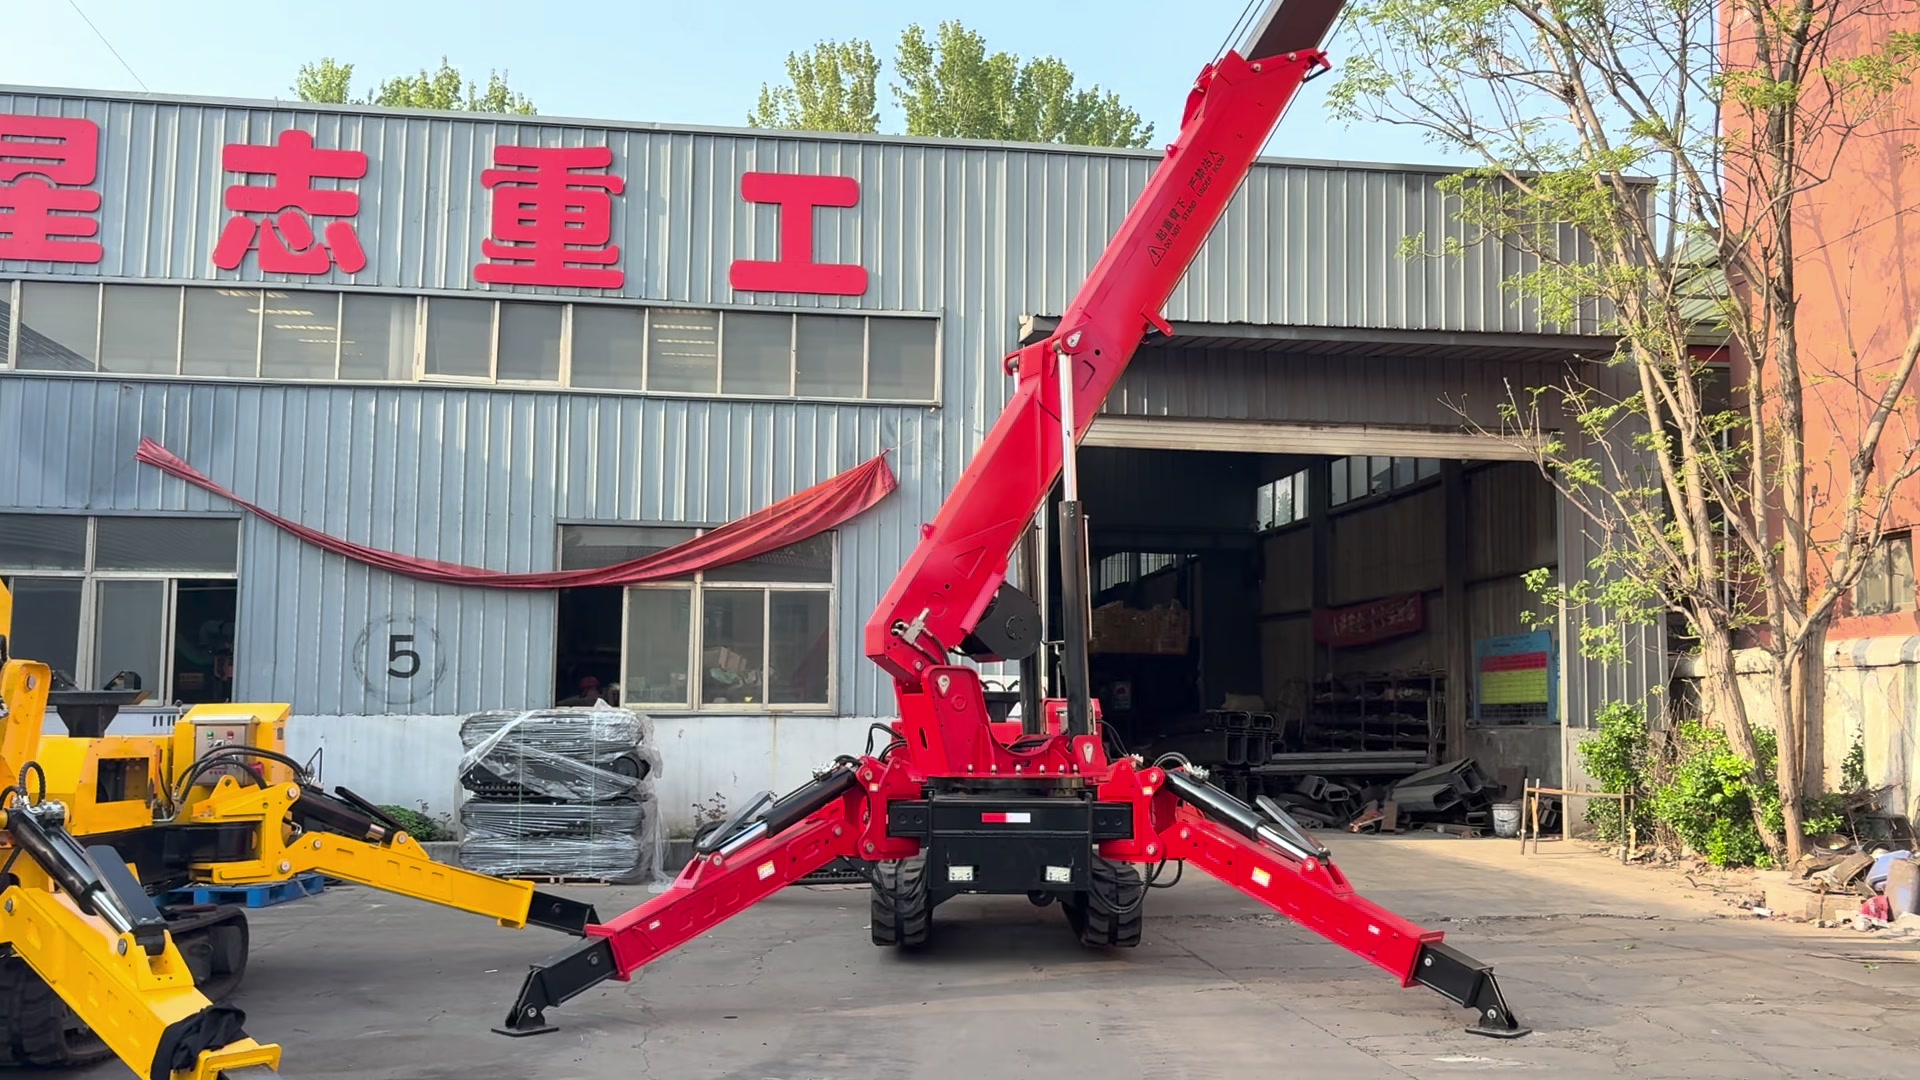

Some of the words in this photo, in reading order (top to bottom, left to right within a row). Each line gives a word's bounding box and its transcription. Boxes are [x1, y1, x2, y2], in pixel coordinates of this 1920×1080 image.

[1188, 150, 1219, 192] 严禁站人
[0, 114, 868, 297] 星志重工
[1164, 238, 1173, 249] DO
[1171, 224, 1182, 238] NOT
[1182, 200, 1198, 222] STAND
[1196, 176, 1213, 198] UNDER
[387, 634, 421, 679] 5
